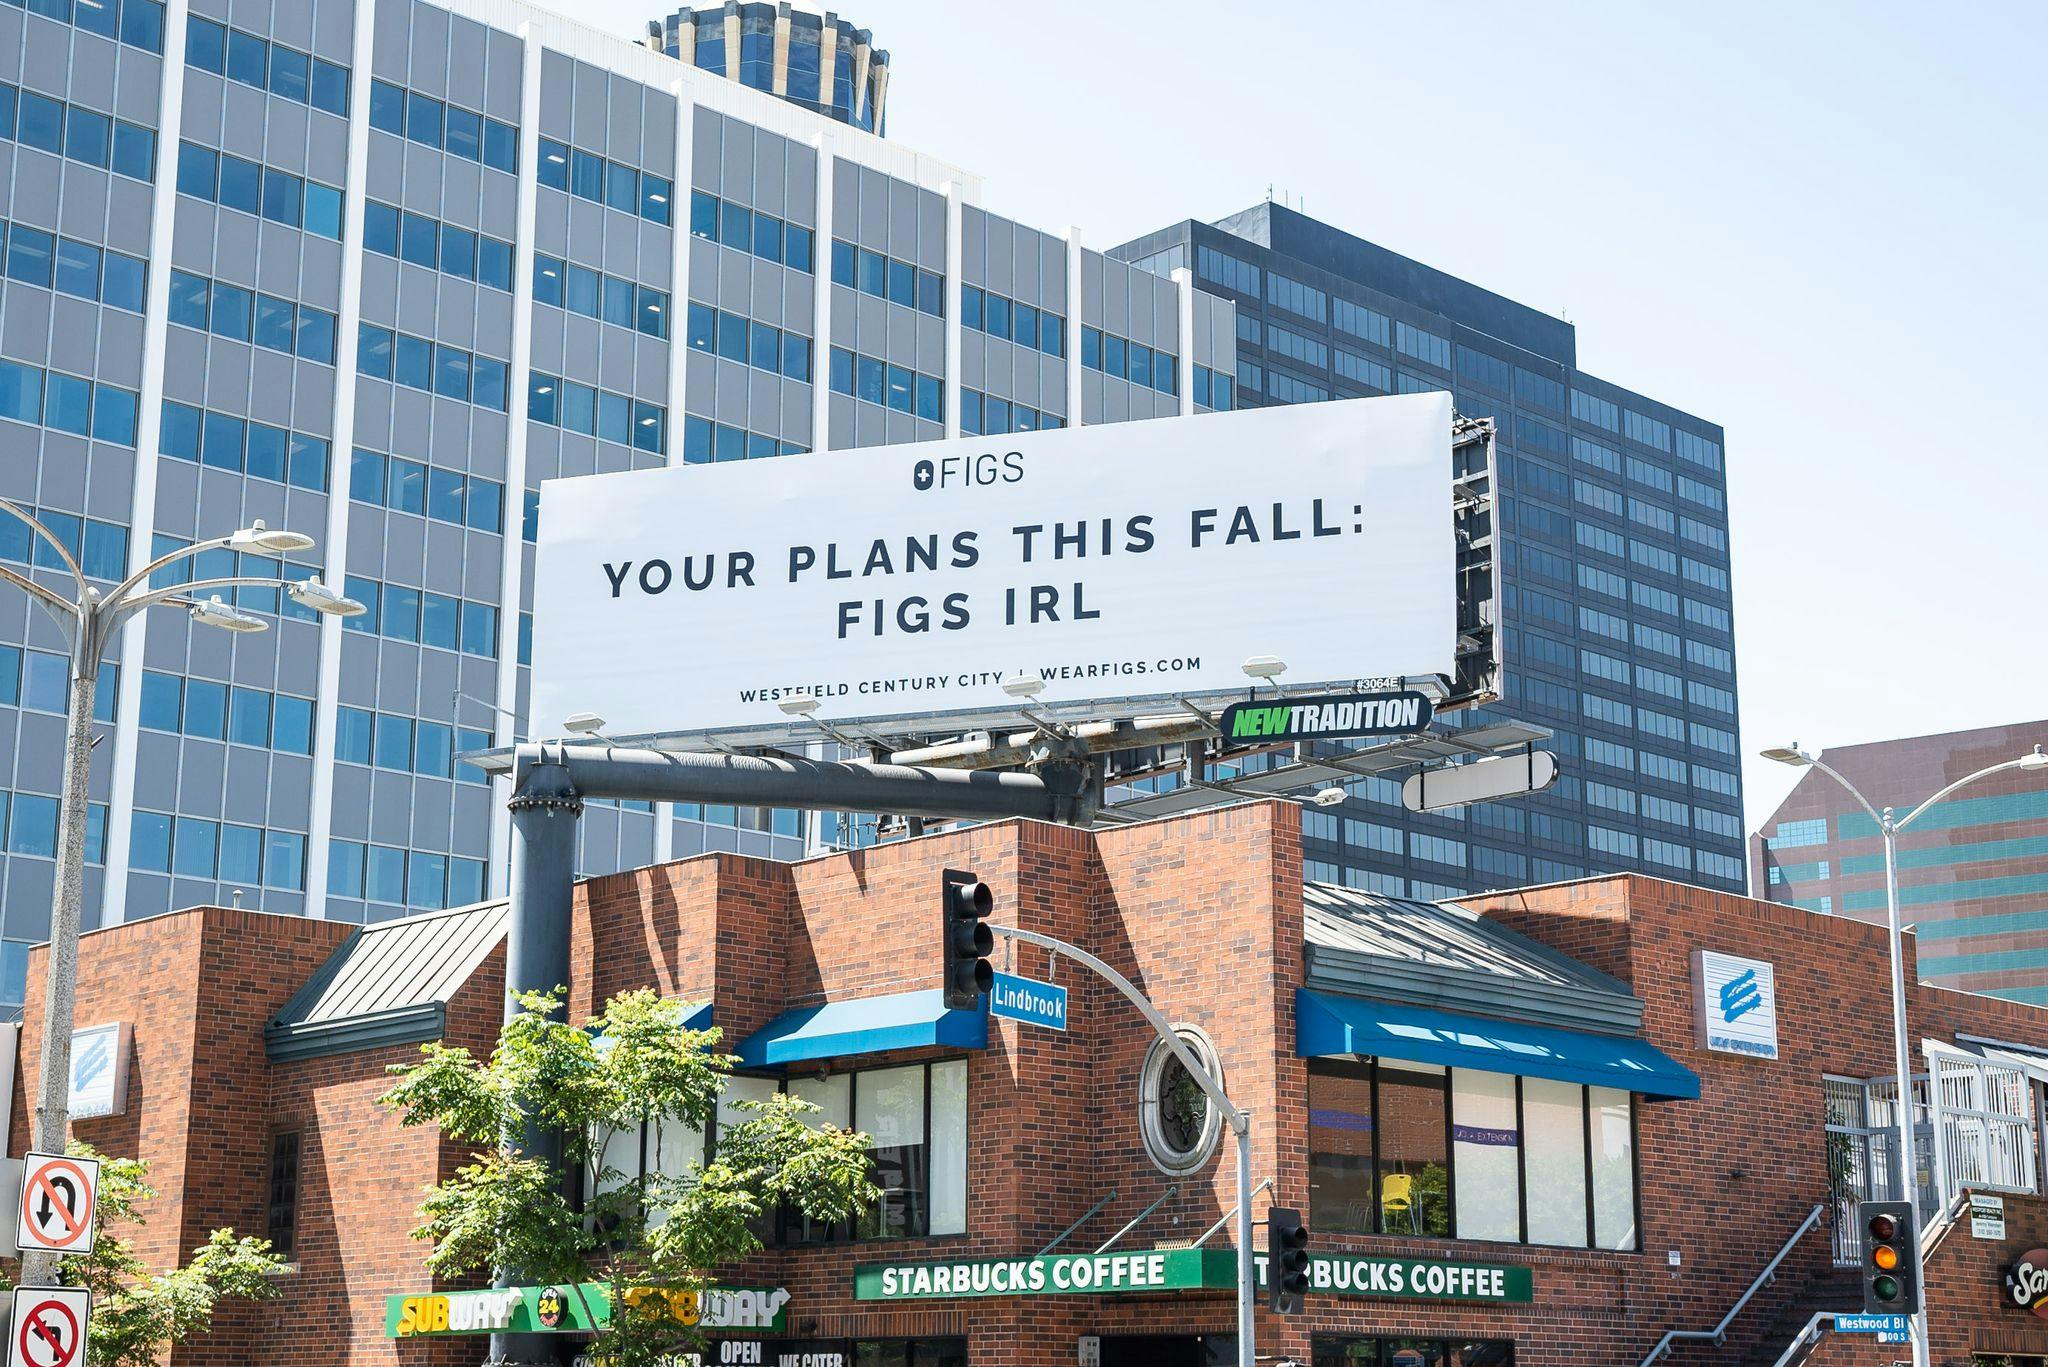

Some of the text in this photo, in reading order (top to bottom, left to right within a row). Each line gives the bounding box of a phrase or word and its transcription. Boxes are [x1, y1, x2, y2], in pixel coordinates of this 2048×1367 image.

[941, 451, 1024, 489] FIGS
[602, 498, 1362, 598] YOUR PLANS THIS FALL:
[837, 581, 1101, 639] FIGS IRL
[740, 656, 1201, 703] WESTFIELD CENTURY CITY WEARFIGS.COM
[1356, 677, 1399, 689] #3064E
[995, 982, 1062, 1018] Lindbrook
[882, 1255, 1165, 1295] STARBUCKS COFFEE
[1253, 1256, 1505, 1297] TBUCKS COFFEE
[396, 1286, 524, 1337] SUBWAY
[539, 1299, 560, 1314] 24
[624, 1287, 791, 1327] SBWAY
[1838, 1317, 1904, 1329] Westwood Bl
[720, 1340, 762, 1364] OPEN
